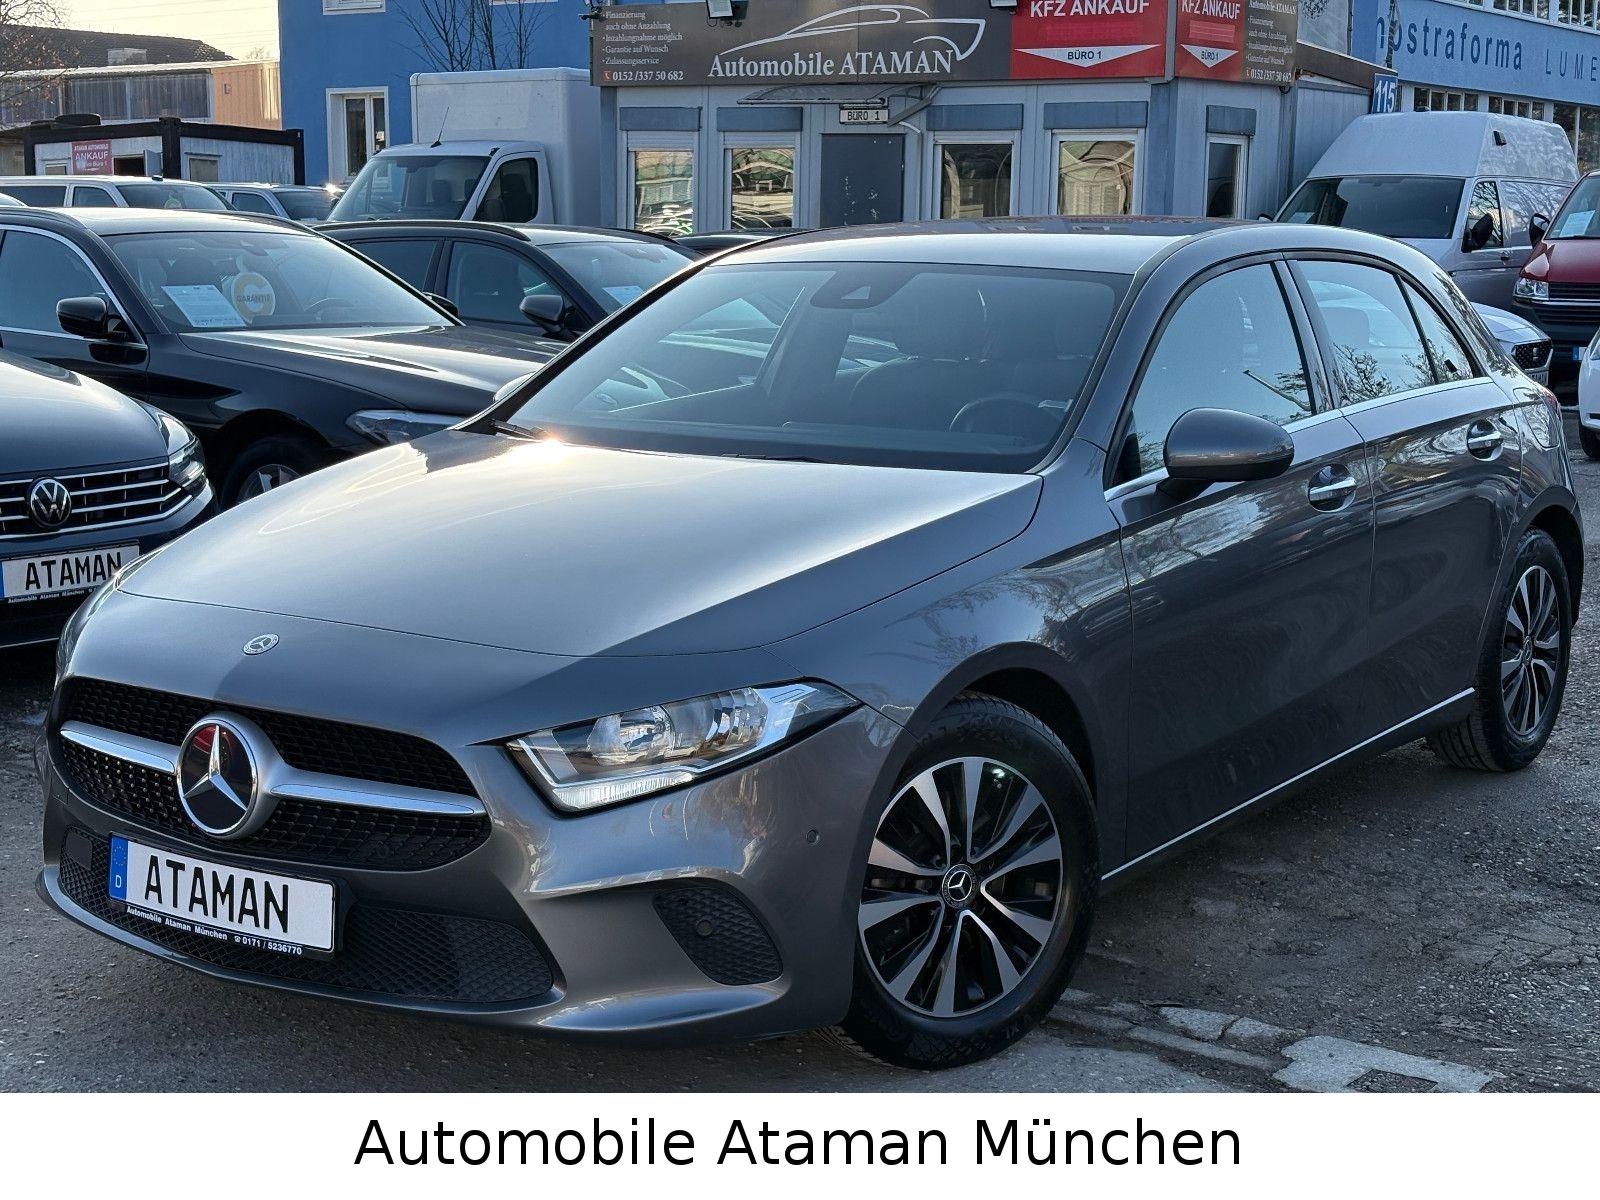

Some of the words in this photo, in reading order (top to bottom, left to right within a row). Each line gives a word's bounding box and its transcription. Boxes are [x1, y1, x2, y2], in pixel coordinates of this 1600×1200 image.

[1030, 0, 1066, 18] KFZ
[1070, 0, 1150, 16] ANKAUF
[1181, 0, 1200, 14] KFZ
[1202, 0, 1240, 19] ANKAUF
[643, 44, 669, 53] Wunsch
[1067, 50, 1095, 60] BÜRO
[1097, 50, 1102, 60] 1
[707, 52, 835, 77] Automobile
[839, 49, 953, 75] ATAMAN
[613, 71, 633, 81] 0152
[655, 71, 666, 81] 50
[667, 71, 684, 81] 682
[1375, 79, 1396, 112] 115
[847, 111, 869, 121] BÜRO
[874, 111, 881, 121] 1
[75, 151, 109, 160] ANKAUF
[25, 552, 121, 590] ATAMAN
[115, 874, 122, 889] D
[144, 854, 289, 934] ATAMAN
[126, 905, 162, 924] Automobile
[165, 919, 192, 932] Ataman
[194, 925, 228, 941] München
[242, 936, 262, 948] 0171
[267, 941, 303, 955] 5236770
